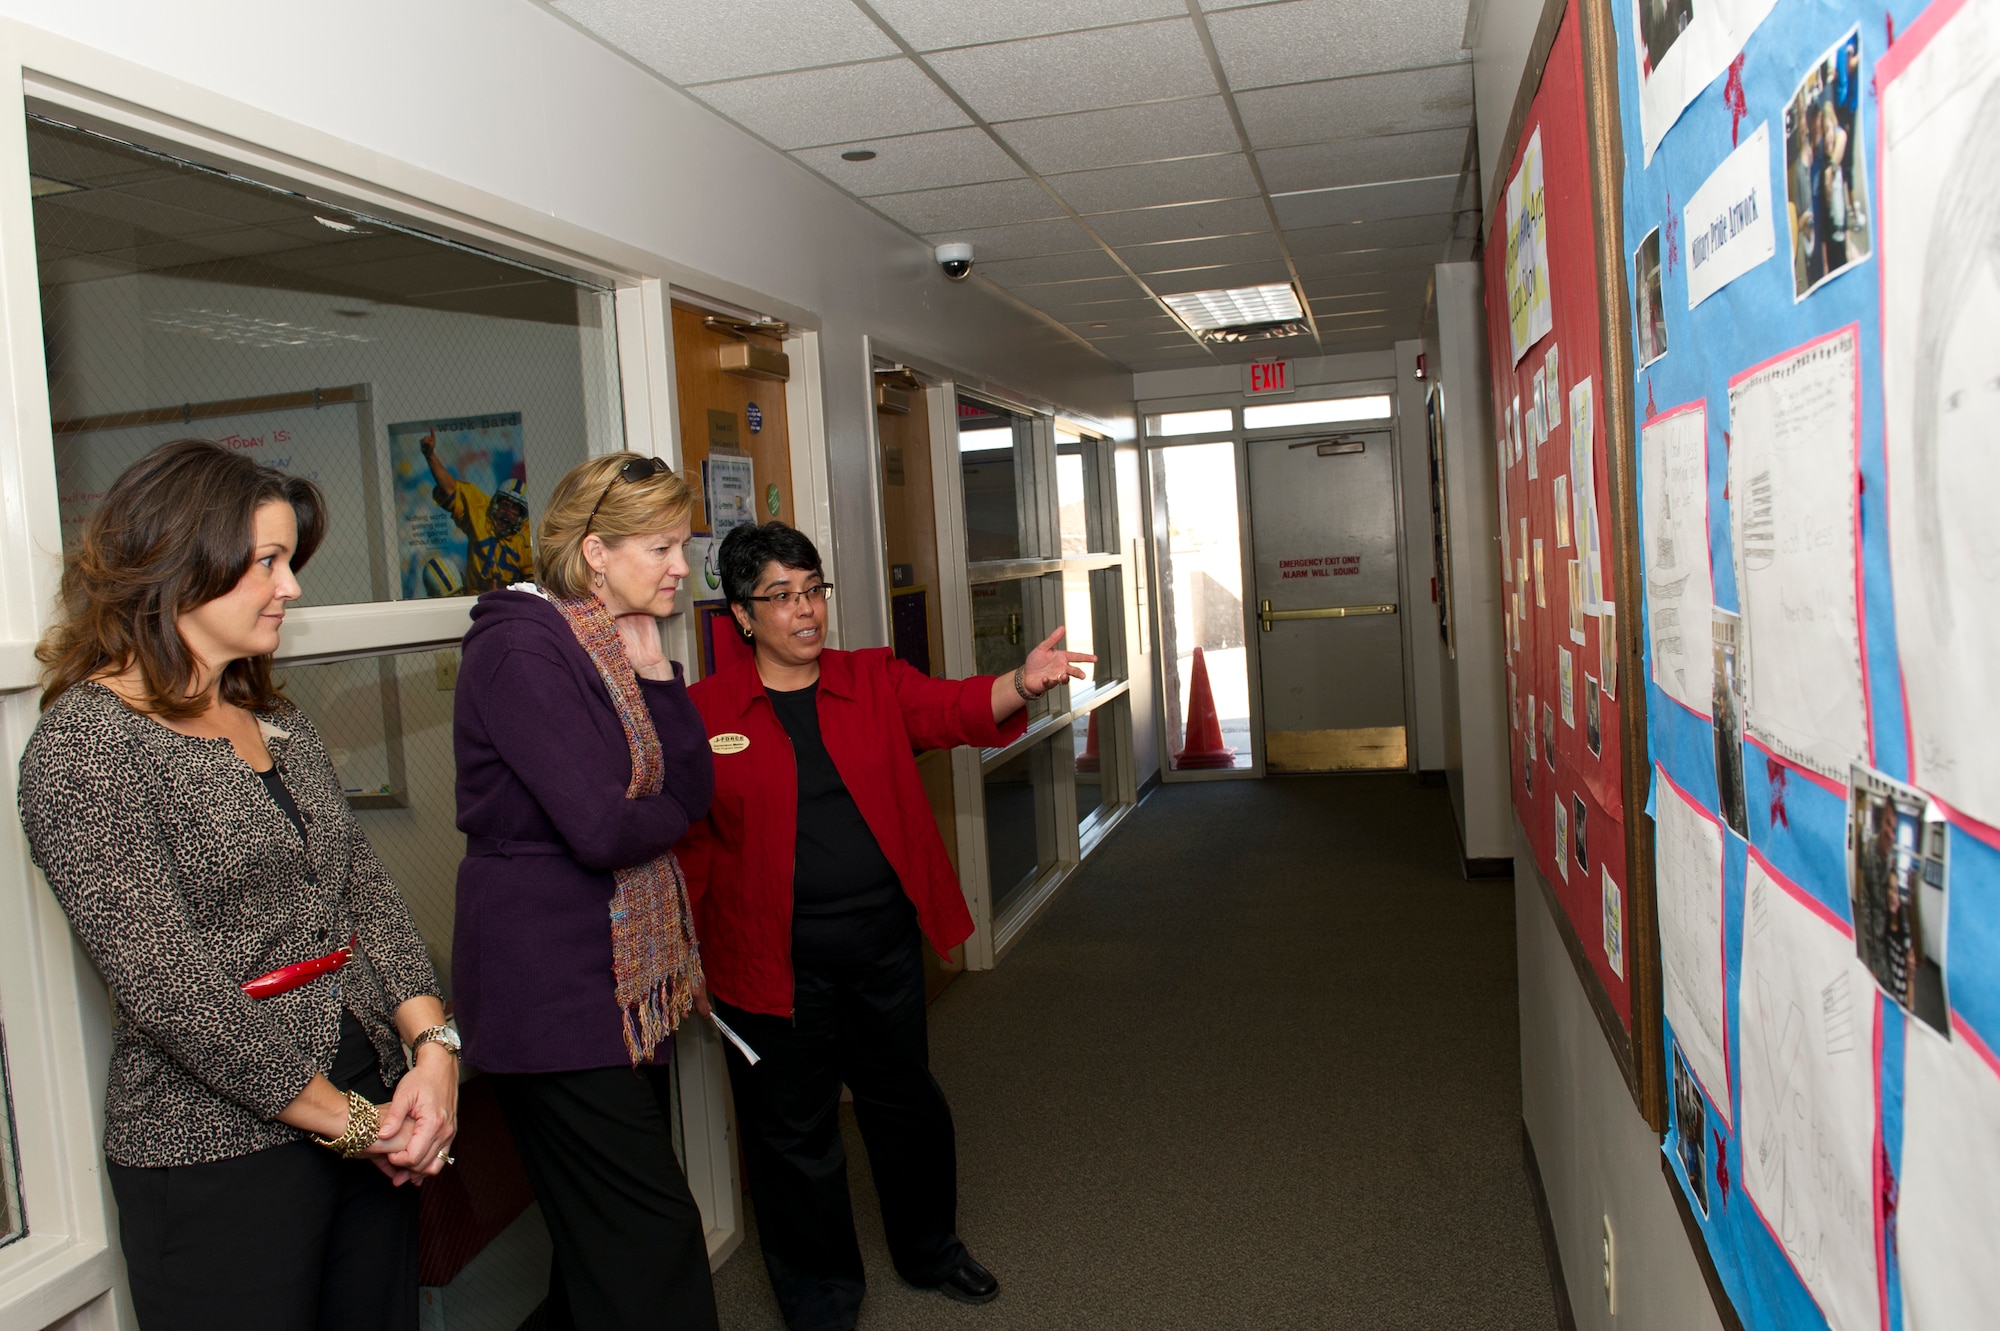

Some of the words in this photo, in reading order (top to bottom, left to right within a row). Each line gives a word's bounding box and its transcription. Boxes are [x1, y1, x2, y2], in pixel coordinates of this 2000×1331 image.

[1691, 231, 1710, 271] Military
[1710, 213, 1728, 254] Pride
[1729, 187, 1759, 240] Artwork
[1251, 361, 1286, 391] EXIT
[437, 419, 475, 433] work
[481, 414, 518, 430] hard
[218, 433, 264, 450] TODAY
[430, 513, 447, 521] worth
[1279, 557, 1323, 569] EMERGENCY
[1325, 556, 1341, 566] EXIT
[1342, 556, 1360, 565] ONLY
[893, 566, 903, 581] 114
[1282, 569, 1308, 579] ALARM
[1312, 568, 1330, 577] WILL
[1333, 567, 1359, 576] SOUND
